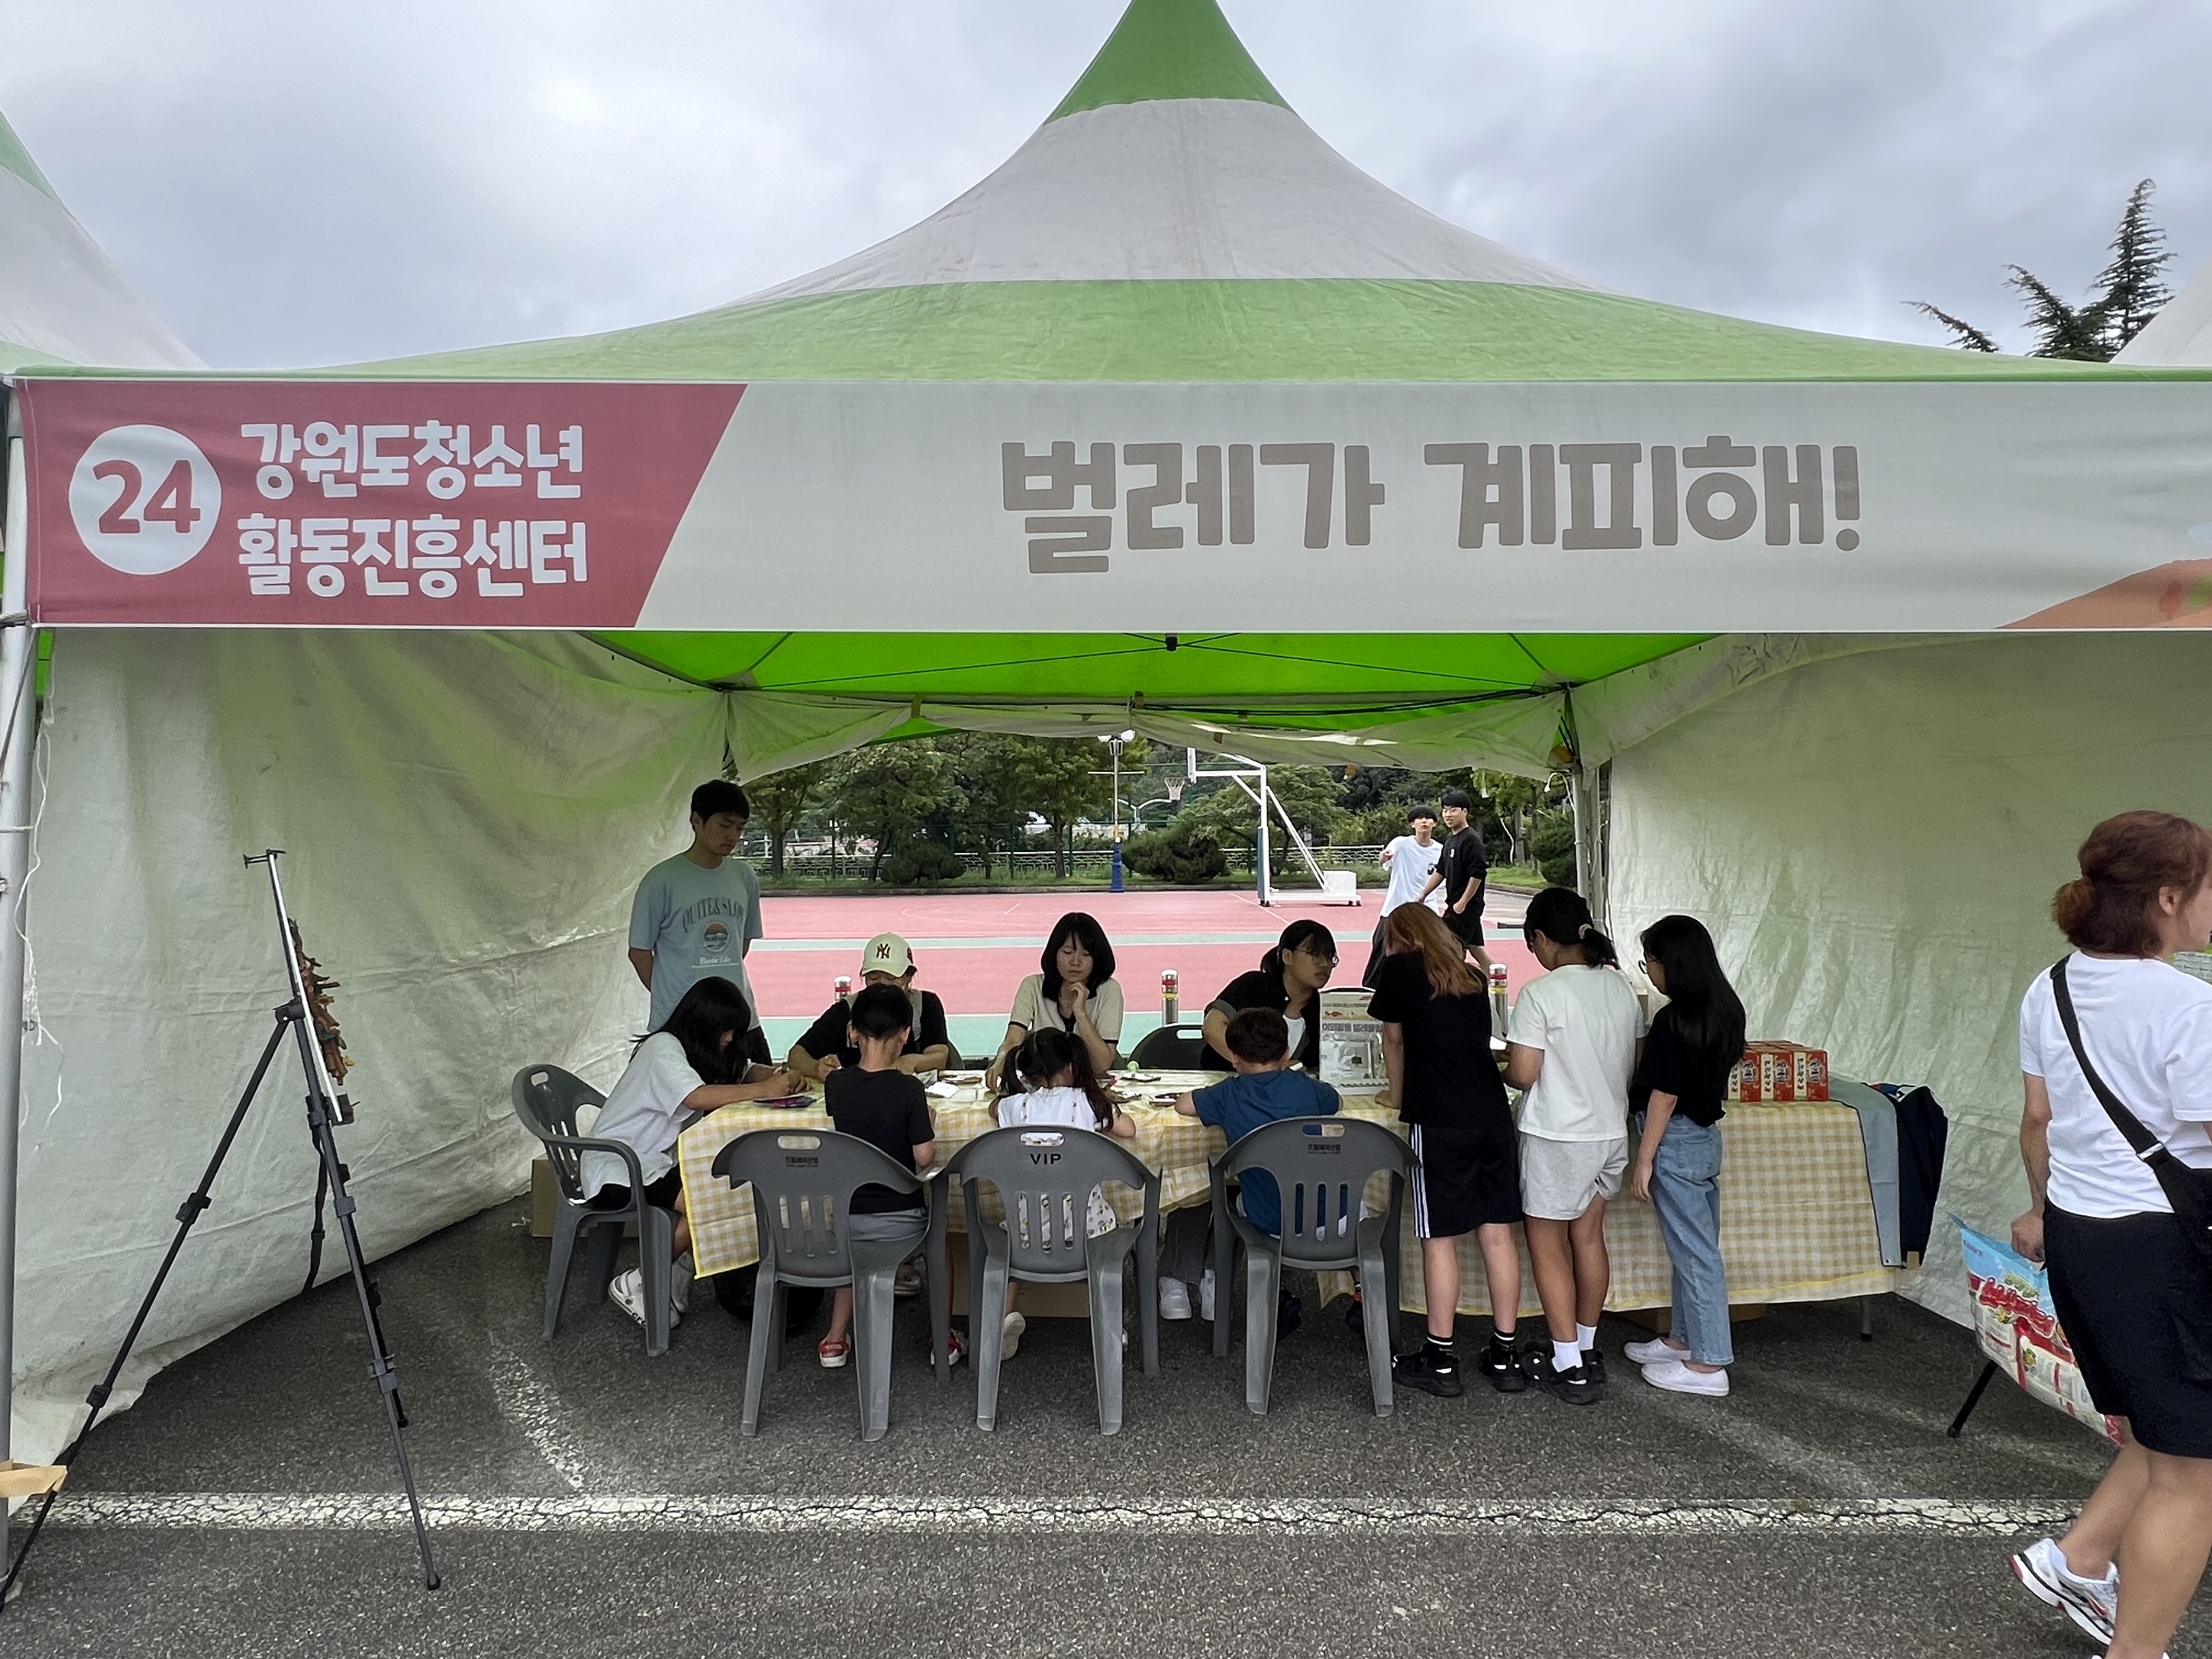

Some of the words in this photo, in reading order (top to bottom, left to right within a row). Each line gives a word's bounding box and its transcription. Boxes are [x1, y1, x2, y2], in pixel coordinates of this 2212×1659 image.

[92, 459, 201, 534] 24
[240, 420, 583, 500] 강원도청소년
[1002, 441, 1385, 574] 벌레가
[1424, 435, 1860, 551] 계피해!
[237, 512, 587, 599] 활동진흥센터
[1030, 1153, 1062, 1165] VIP
